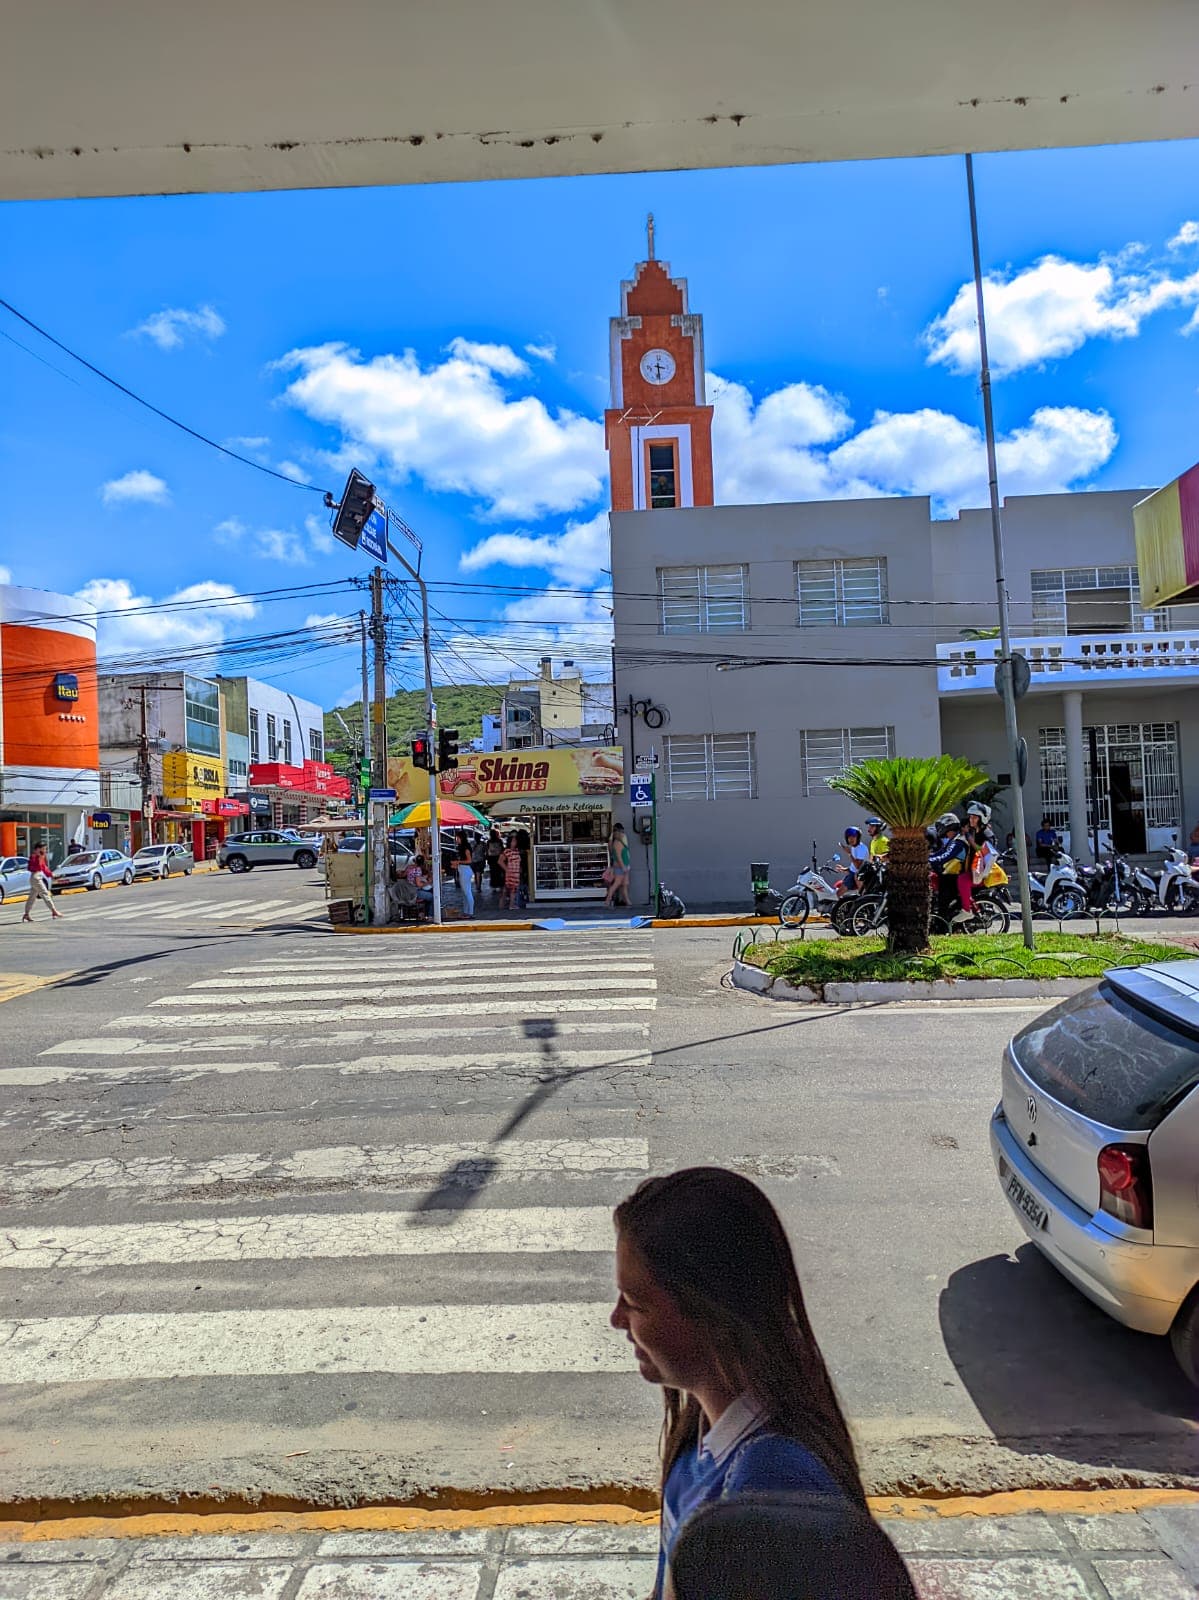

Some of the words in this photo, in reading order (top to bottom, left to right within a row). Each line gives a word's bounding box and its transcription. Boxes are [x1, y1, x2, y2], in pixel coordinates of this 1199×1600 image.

[58, 685, 78, 698] Itaú
[479, 757, 549, 782] Skina
[486, 780, 545, 792] LANCHES
